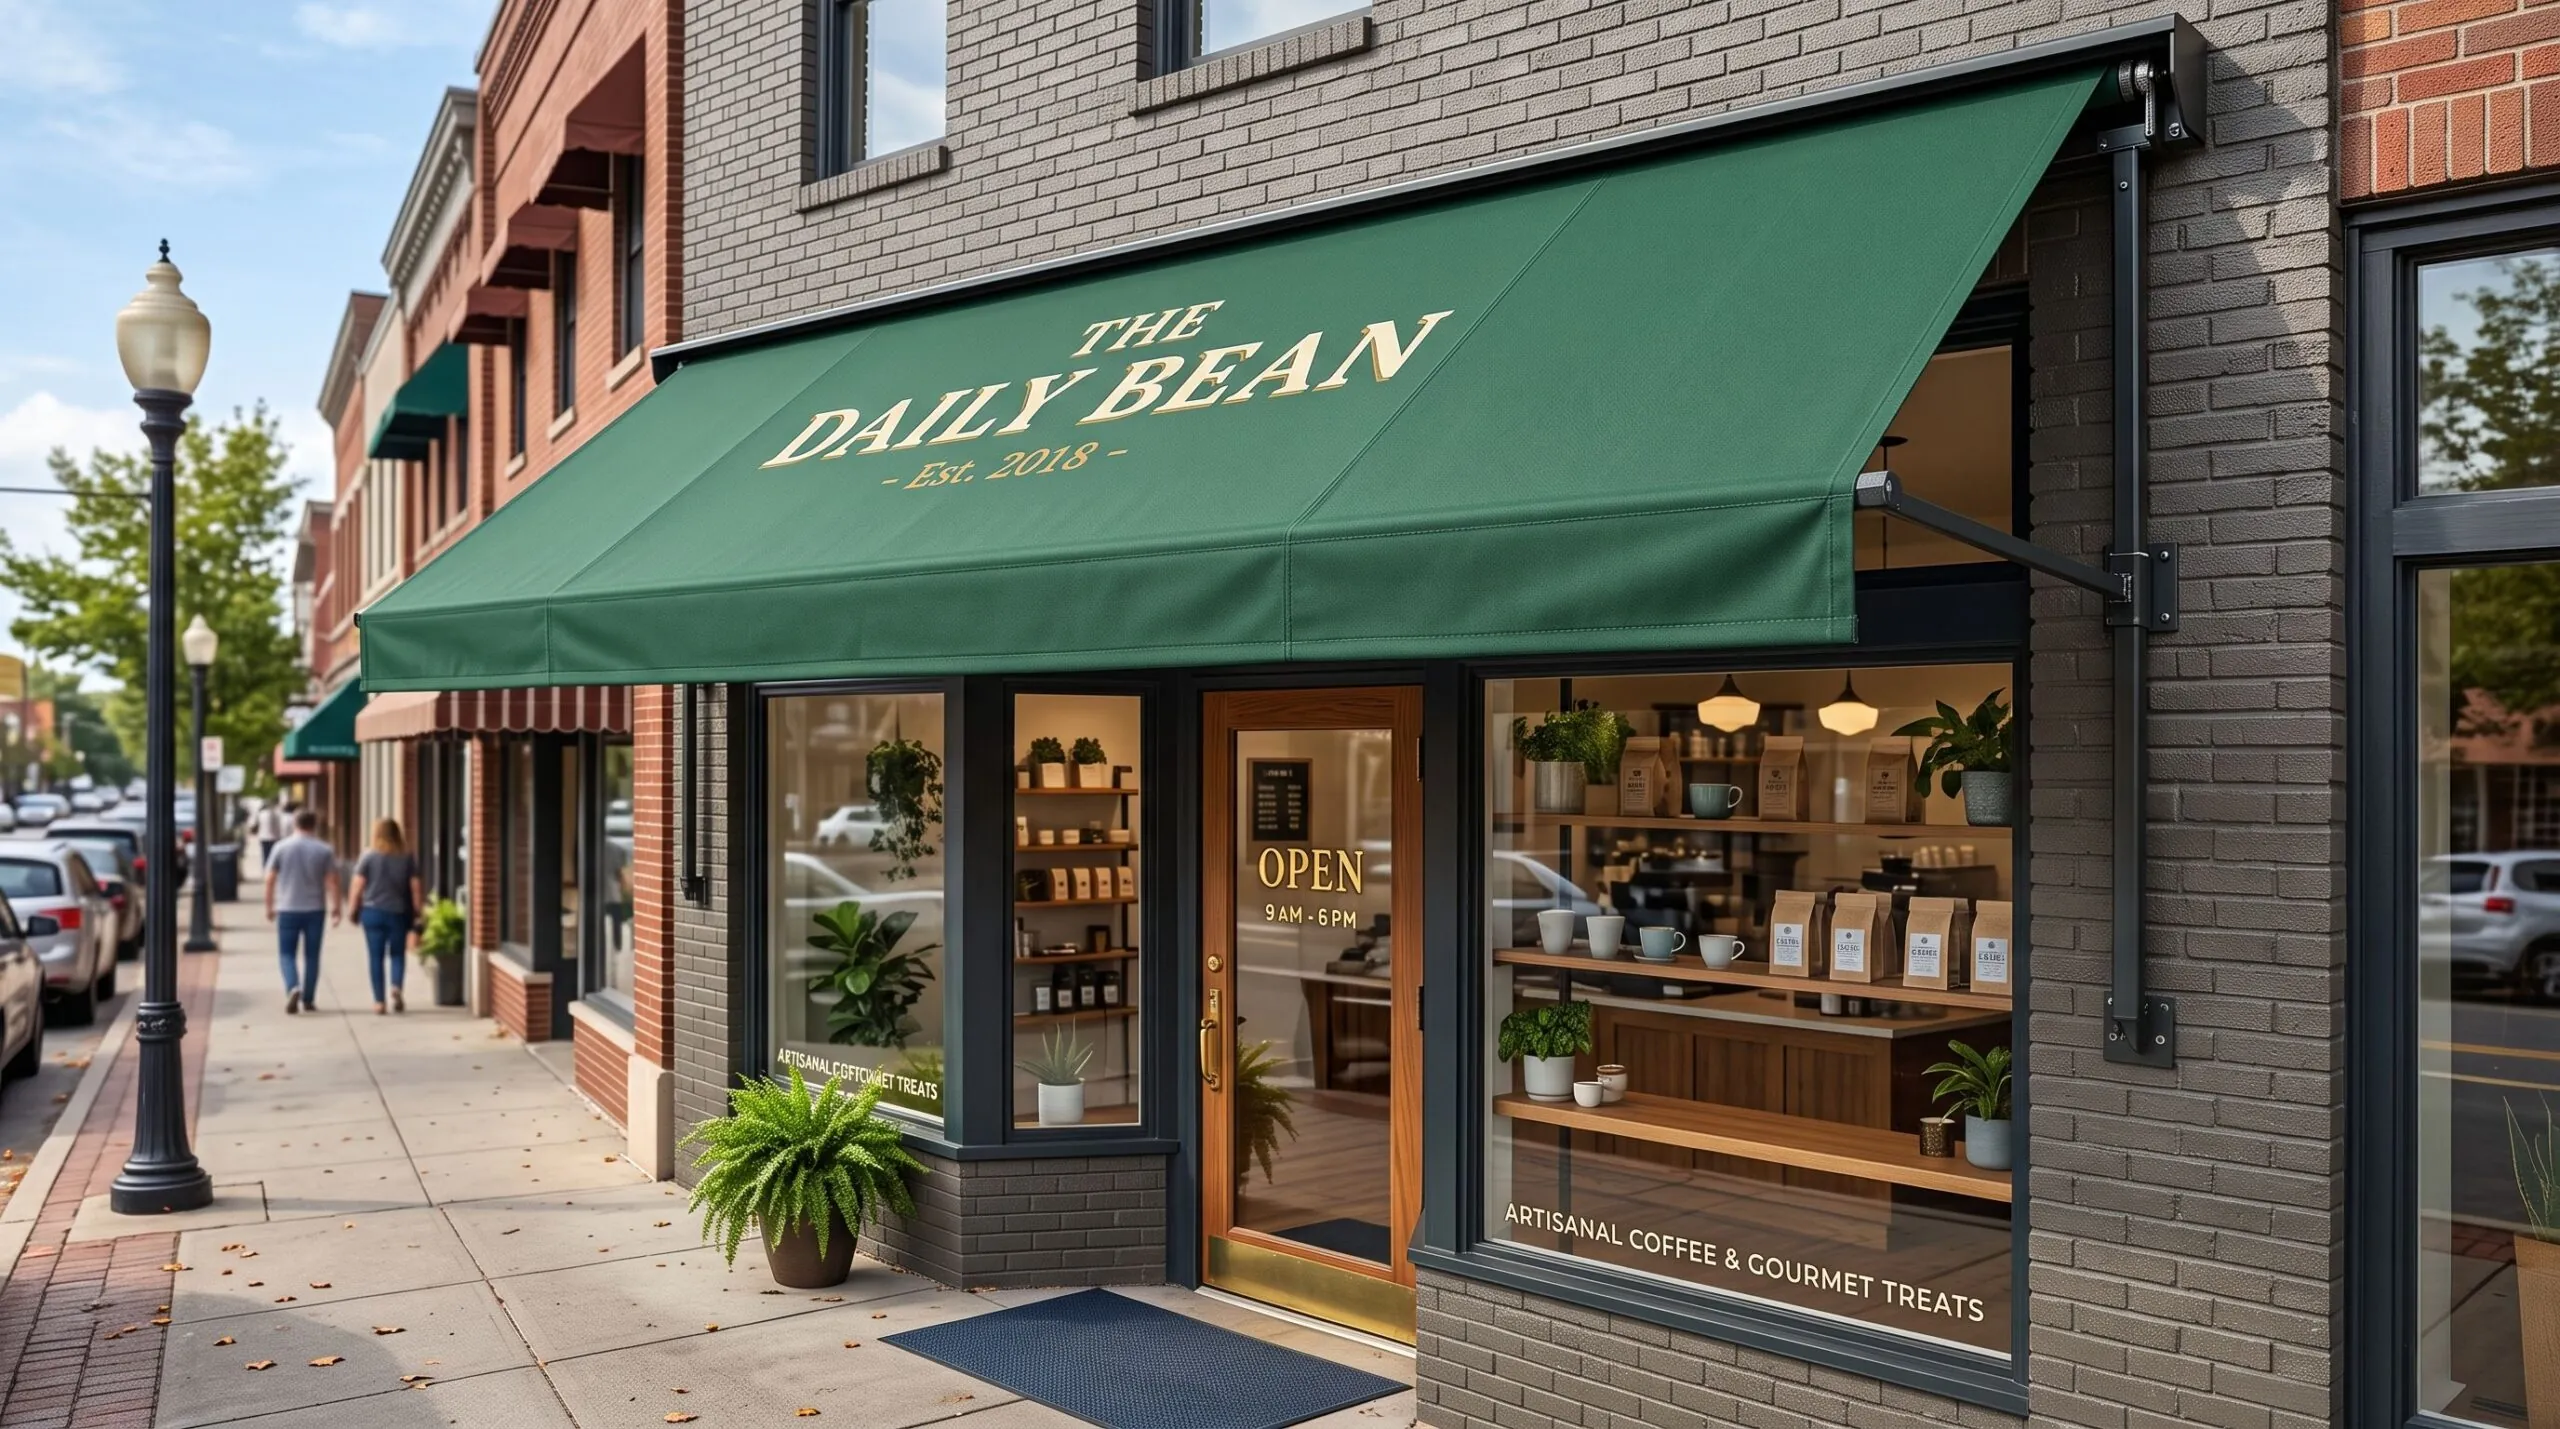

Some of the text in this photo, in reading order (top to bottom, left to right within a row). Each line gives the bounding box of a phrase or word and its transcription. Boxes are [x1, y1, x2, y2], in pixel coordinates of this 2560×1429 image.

[1070, 300, 1226, 359] THE
[758, 309, 1456, 470] DAILY BEAN
[902, 459, 976, 490] Est.
[984, 441, 1100, 480] 2018
[1258, 847, 1364, 894] OPEN
[777, 1047, 831, 1076] ARTISANAL
[897, 1076, 938, 1101] TREATS
[1504, 1202, 1985, 1323] ARTISANAL COFFEE & GOURMET TREATS
